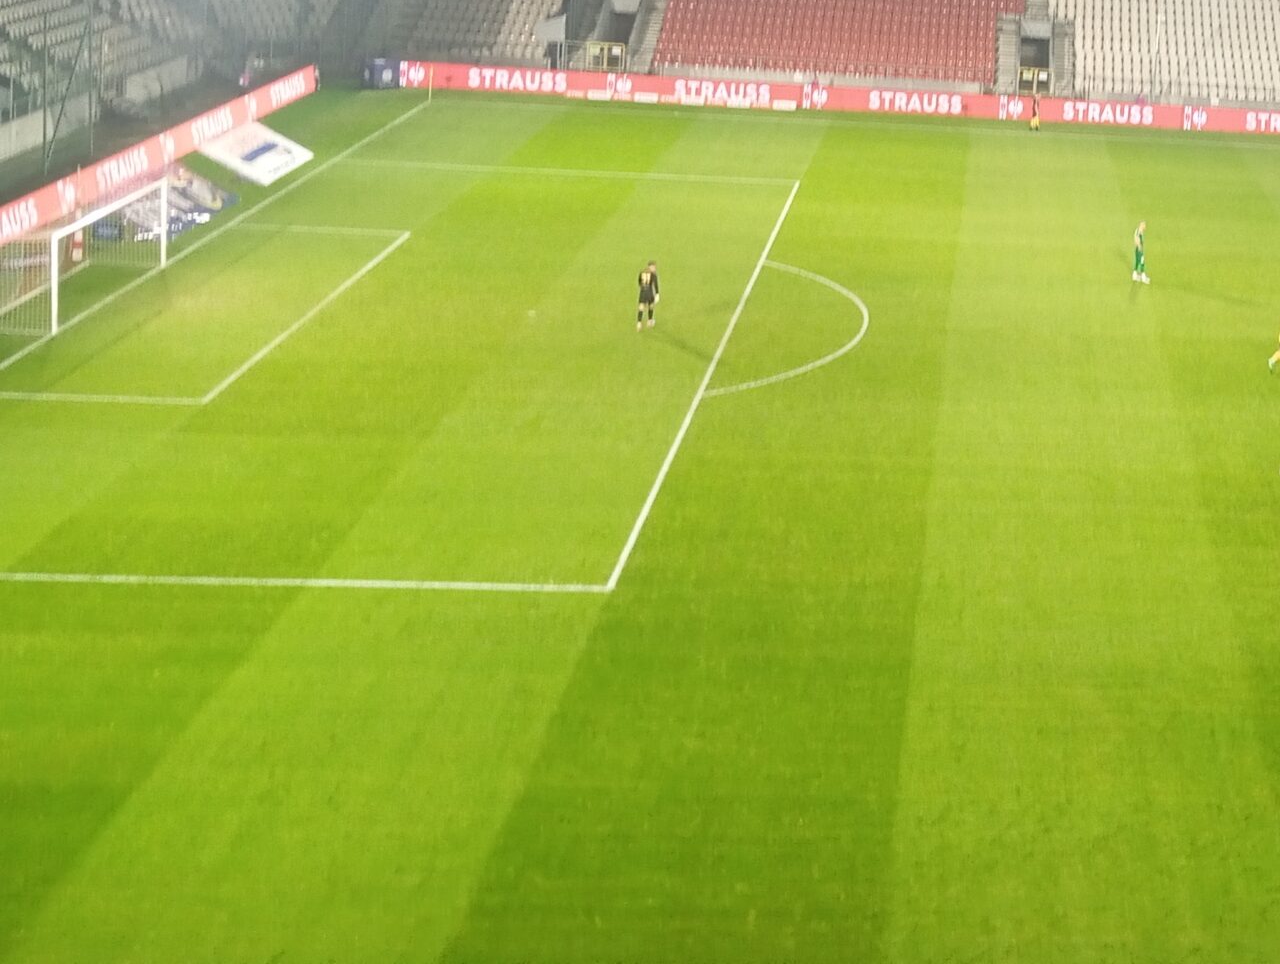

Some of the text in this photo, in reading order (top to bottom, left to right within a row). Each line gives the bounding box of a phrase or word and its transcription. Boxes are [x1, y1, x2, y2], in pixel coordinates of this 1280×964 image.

[468, 67, 567, 93] STRAUSS
[675, 79, 770, 108] STRAUSS
[869, 90, 962, 115] STRAUSS
[1063, 101, 1153, 125] STRAUSS
[96, 145, 148, 193] STRAUSS
